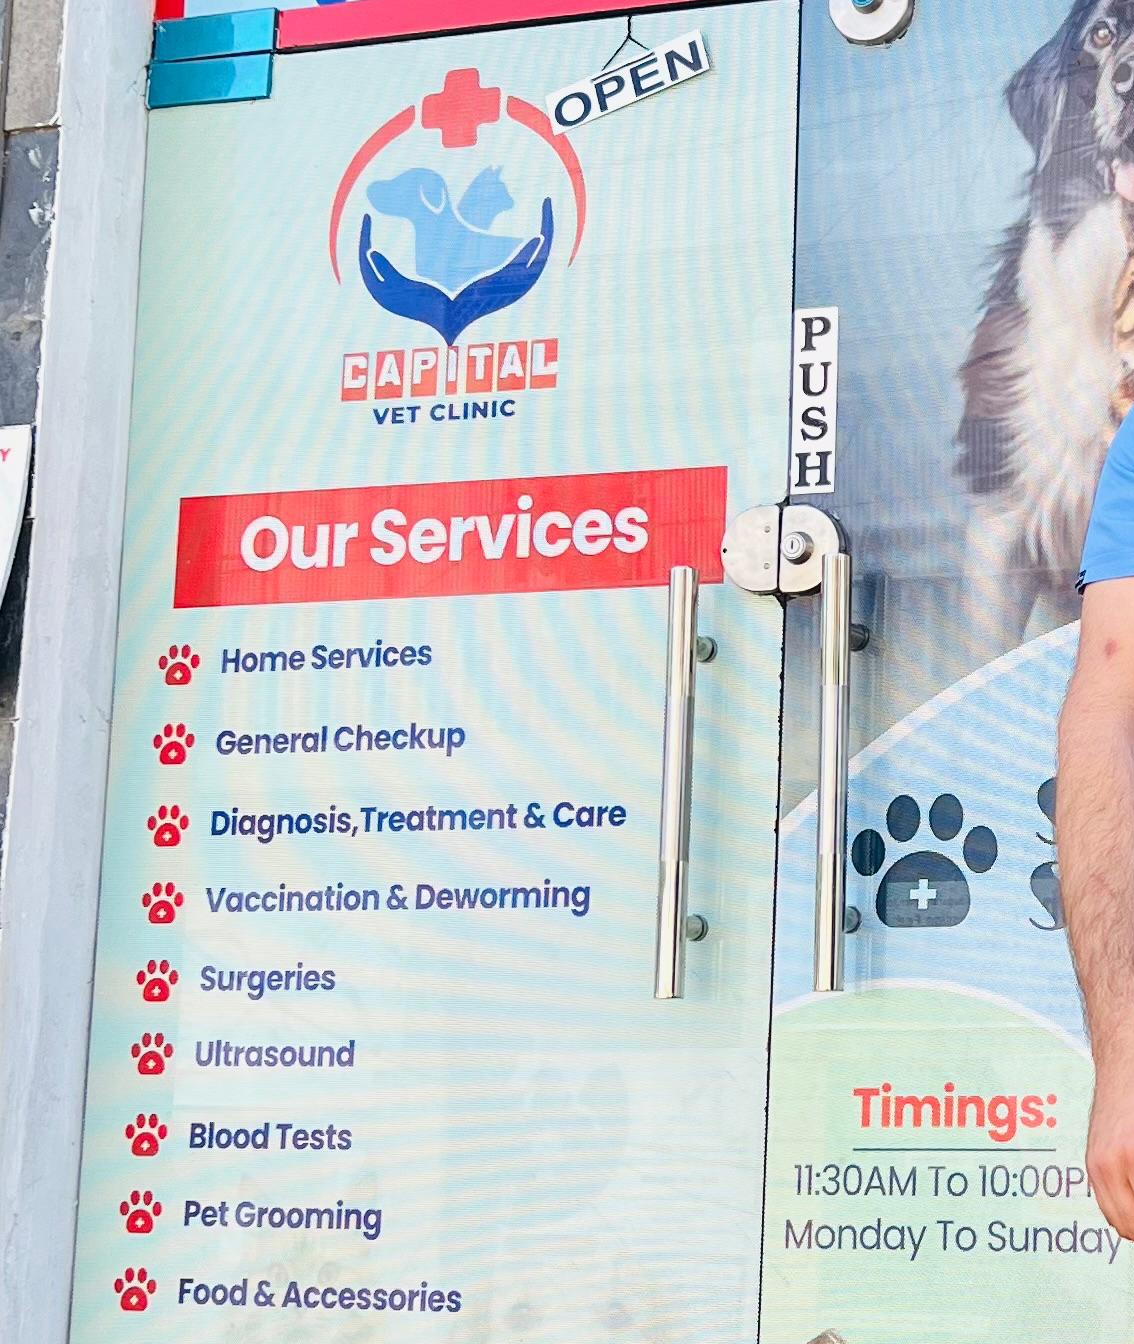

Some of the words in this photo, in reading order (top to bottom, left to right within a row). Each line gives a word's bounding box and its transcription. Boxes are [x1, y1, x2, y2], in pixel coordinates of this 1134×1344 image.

[553, 41, 702, 128] OPEN
[342, 339, 559, 391] CAPITAL
[373, 405, 421, 425] VET
[430, 399, 516, 422] CLINIC
[795, 317, 832, 488] PUSH
[240, 514, 359, 572] Our
[370, 495, 650, 565] Services
[221, 646, 306, 674] Home
[311, 639, 432, 670] Services
[215, 726, 328, 756] General
[333, 723, 466, 757] Checkup
[523, 804, 546, 828] &
[552, 801, 627, 828] Care
[205, 884, 380, 914] Vaccination
[386, 886, 410, 911] &
[415, 878, 591, 917] Deworming
[200, 962, 337, 1001] Surgeries
[195, 1039, 355, 1068] Ultrasound
[852, 1082, 1057, 1143] Timings:
[188, 1122, 269, 1150] Blood
[276, 1123, 353, 1151] Tests
[794, 1164, 917, 1197] 11:30AM
[928, 1166, 969, 1197] To
[979, 1164, 1092, 1198] 10:00P
[183, 1200, 229, 1228] Pet
[235, 1200, 382, 1240] Grooming
[784, 1218, 927, 1261] Monday
[936, 1220, 978, 1252] To
[987, 1220, 1122, 1264] Sunday
[178, 1277, 248, 1306] Food
[253, 1281, 276, 1307] &
[281, 1280, 462, 1313] Accessories
